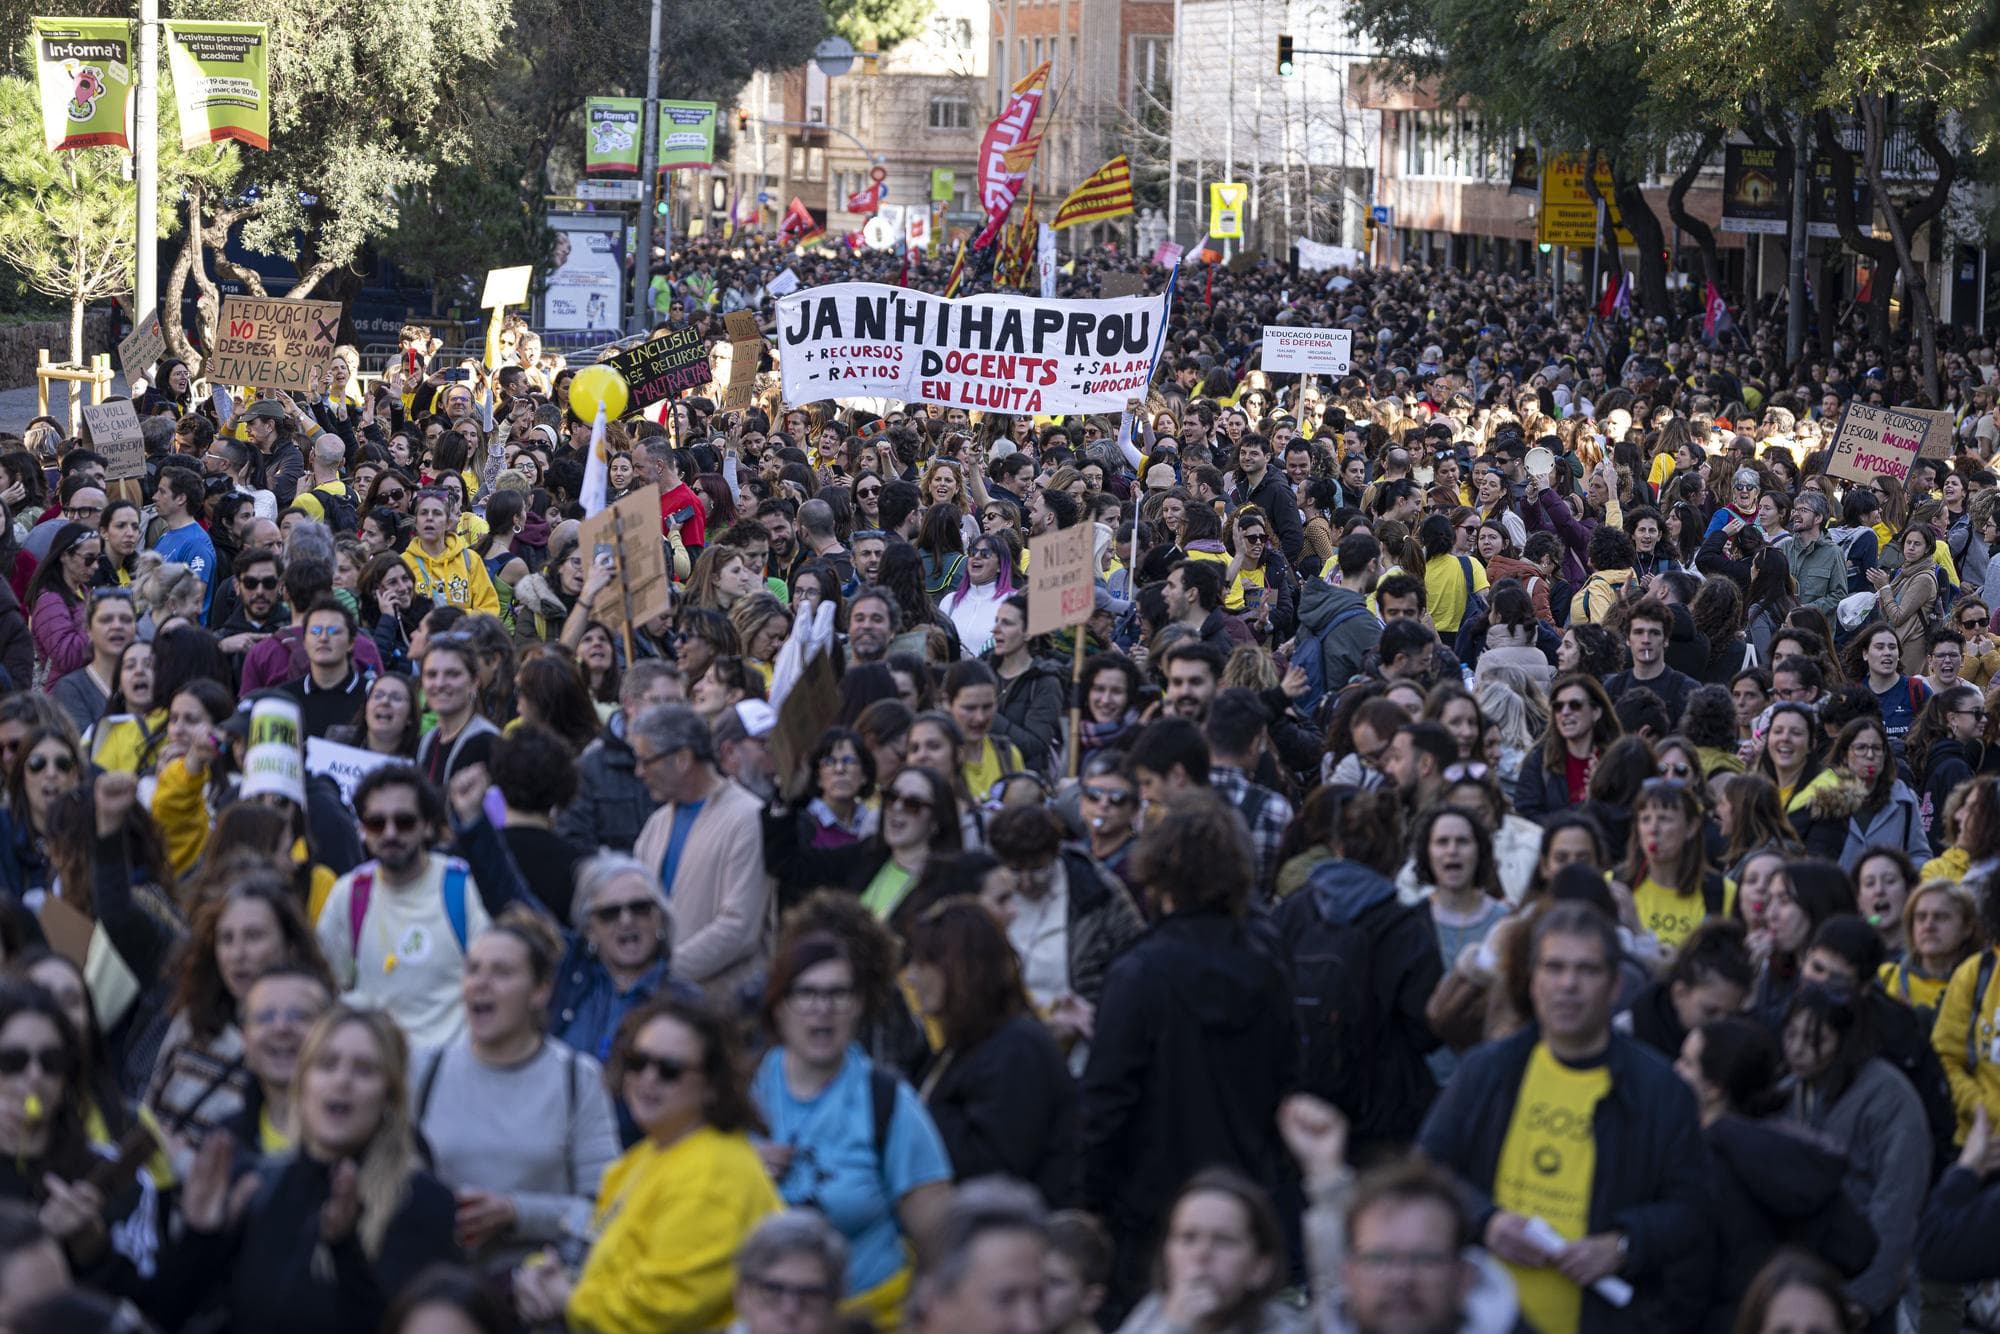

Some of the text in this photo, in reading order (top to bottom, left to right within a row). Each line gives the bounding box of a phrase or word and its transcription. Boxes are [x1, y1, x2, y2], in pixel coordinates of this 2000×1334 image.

[178, 33, 258, 45] Activitats per trobar
[216, 44, 246, 52] itinerari
[230, 303, 323, 324] L'EDUCACIÓ
[786, 296, 843, 346] JA
[230, 320, 308, 341] NO ÉS UNA
[1265, 330, 1348, 341] L'EDUCACIÓ PÚBLICA
[219, 340, 277, 357] DESPESA
[305, 345, 331, 360] UNA
[626, 326, 699, 367] INCLUSIÓ
[820, 345, 903, 362] RECURSOS
[1292, 339, 1333, 348] DEFENSA
[651, 345, 707, 374] RECURSOS
[920, 349, 1059, 386] DOCENTS
[632, 361, 712, 406] MALTRACTAR
[922, 380, 951, 402] EN
[85, 406, 128, 421] NO VULL
[1850, 404, 1878, 421] SENSE
[1882, 413, 1929, 434] RECURSOS
[111, 430, 123, 441] DE
[1842, 423, 1879, 442] L'ESCOLA
[1837, 438, 1854, 454] ÉS
[1648, 912, 1690, 933] SOS
